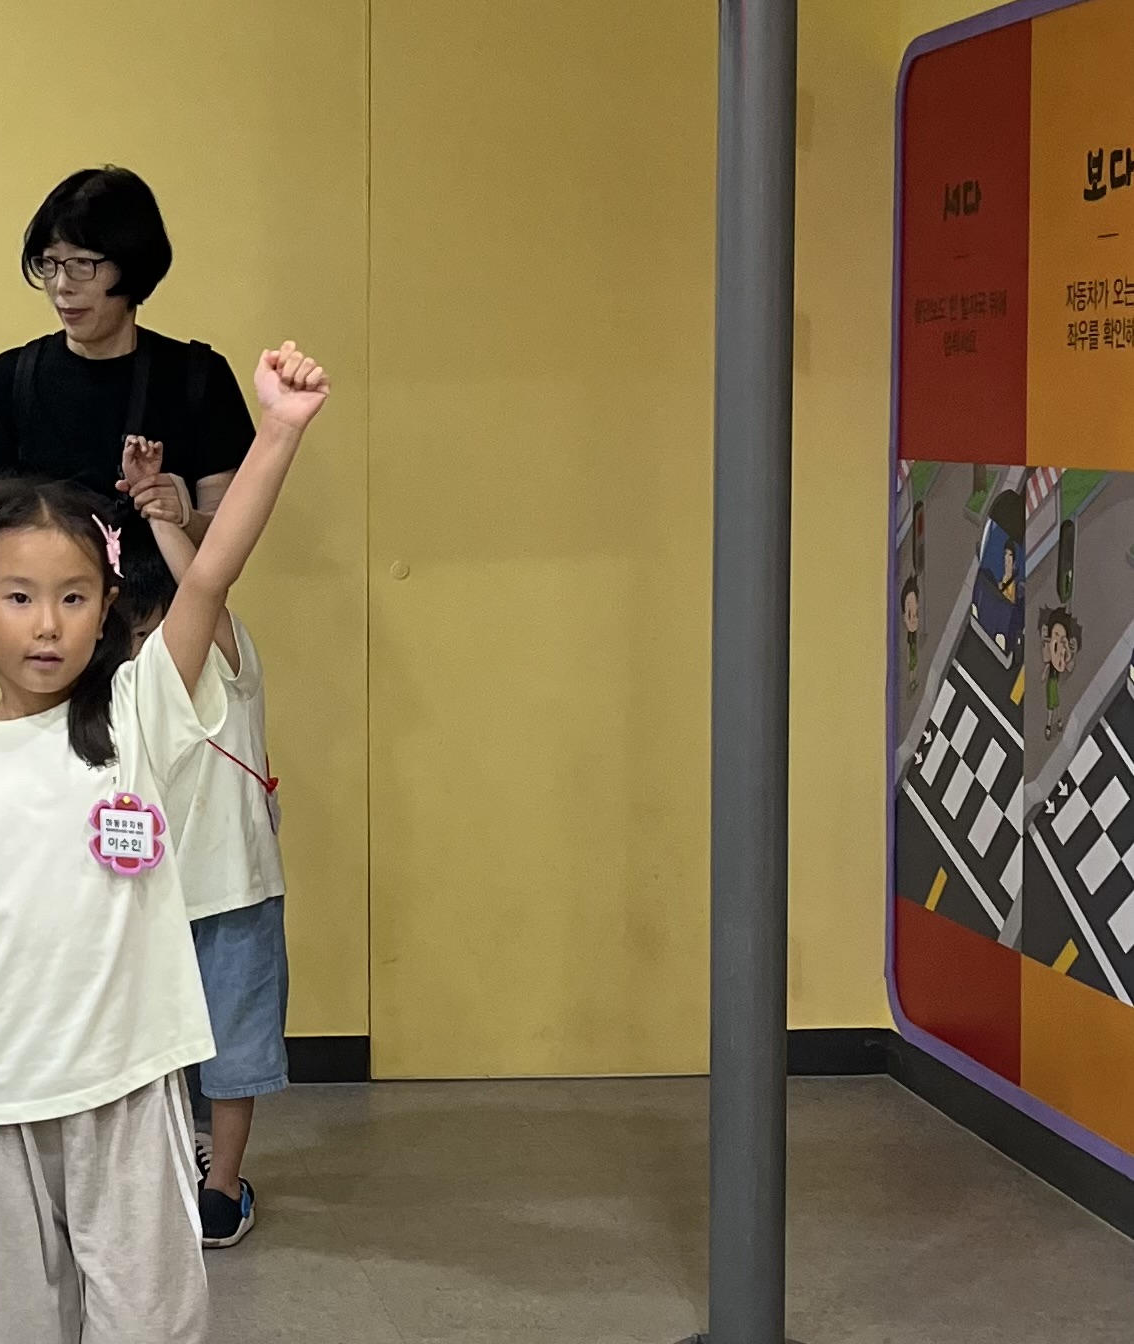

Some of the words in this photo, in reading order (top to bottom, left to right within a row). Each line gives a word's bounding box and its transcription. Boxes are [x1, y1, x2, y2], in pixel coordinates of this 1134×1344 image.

[1083, 147, 1134, 201] 보다
[1066, 278, 1109, 311] 자동차가
[1067, 320, 1099, 351] 좌우를
[108, 837, 142, 852] 이수인
